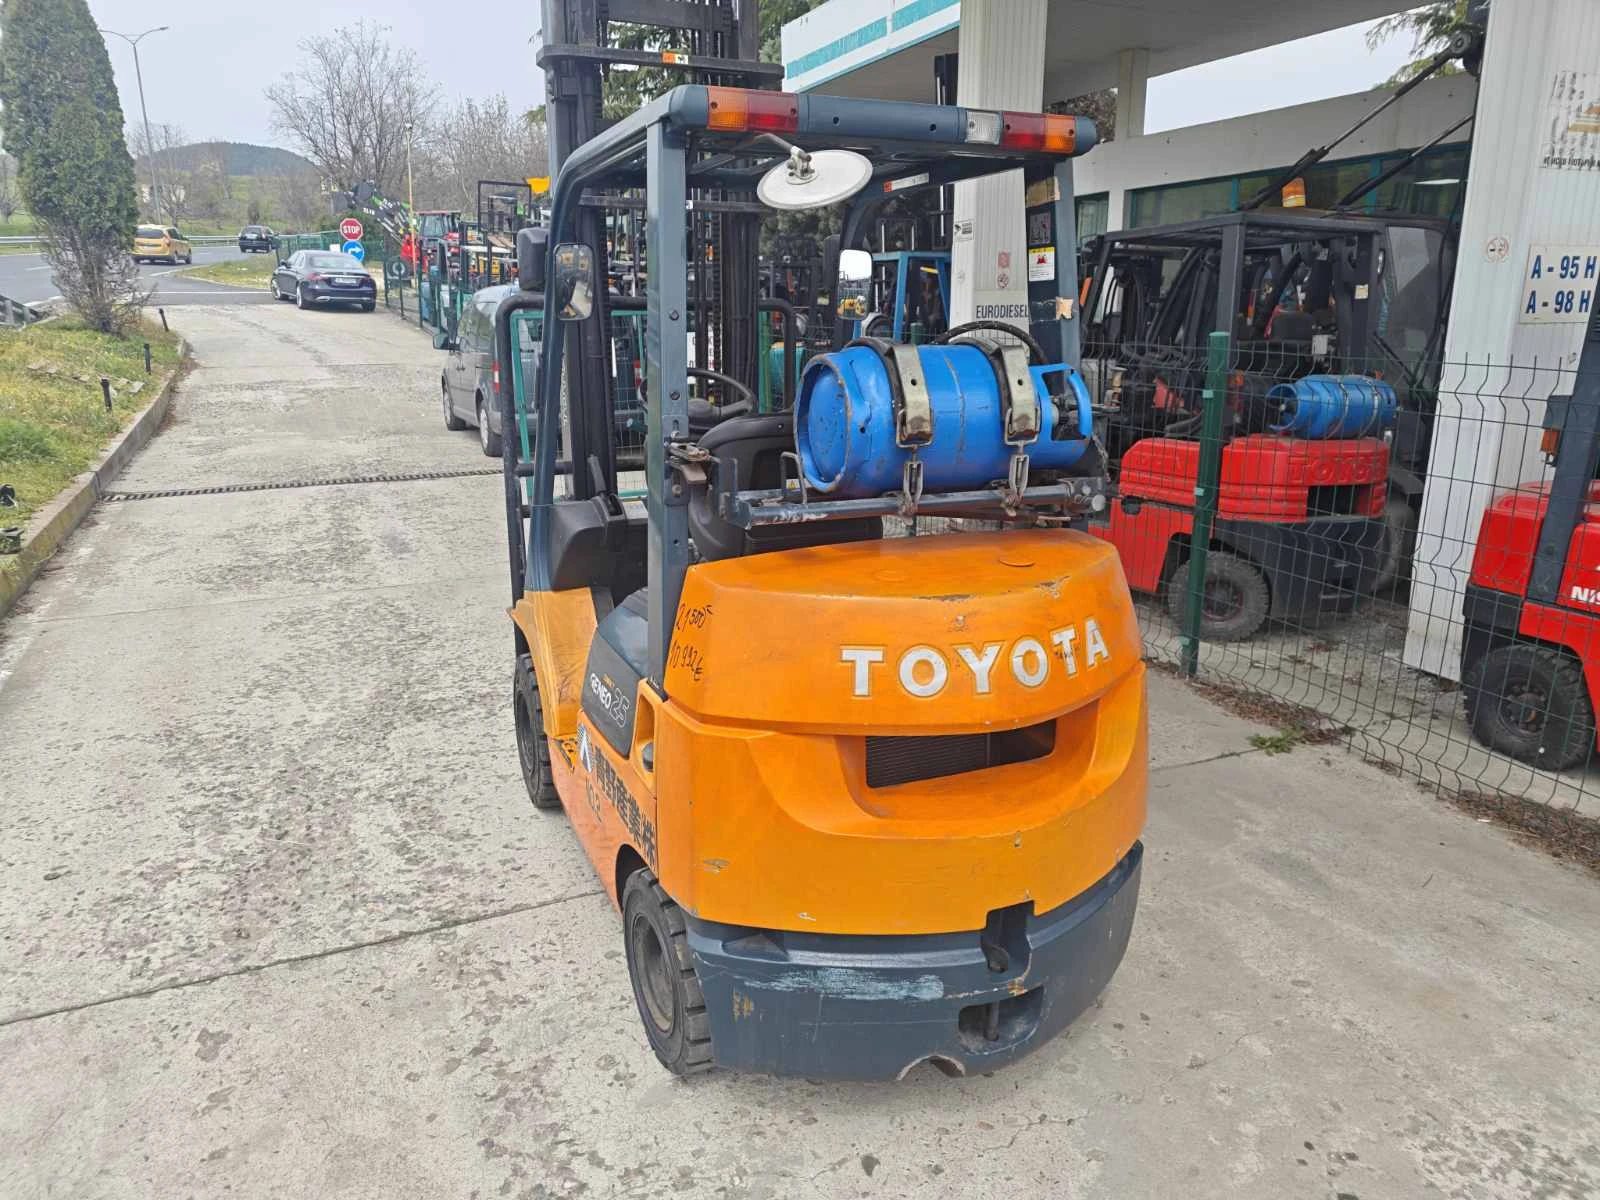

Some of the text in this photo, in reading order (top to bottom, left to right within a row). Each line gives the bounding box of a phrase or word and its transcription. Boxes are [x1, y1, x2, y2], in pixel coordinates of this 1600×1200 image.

[343, 225, 360, 233] STOP
[1559, 255, 1581, 279] 95
[976, 304, 1029, 319] EURODIESEL
[1554, 290, 1575, 314] 98
[841, 618, 1110, 697] TOYOTA
[610, 687, 631, 728] 25
